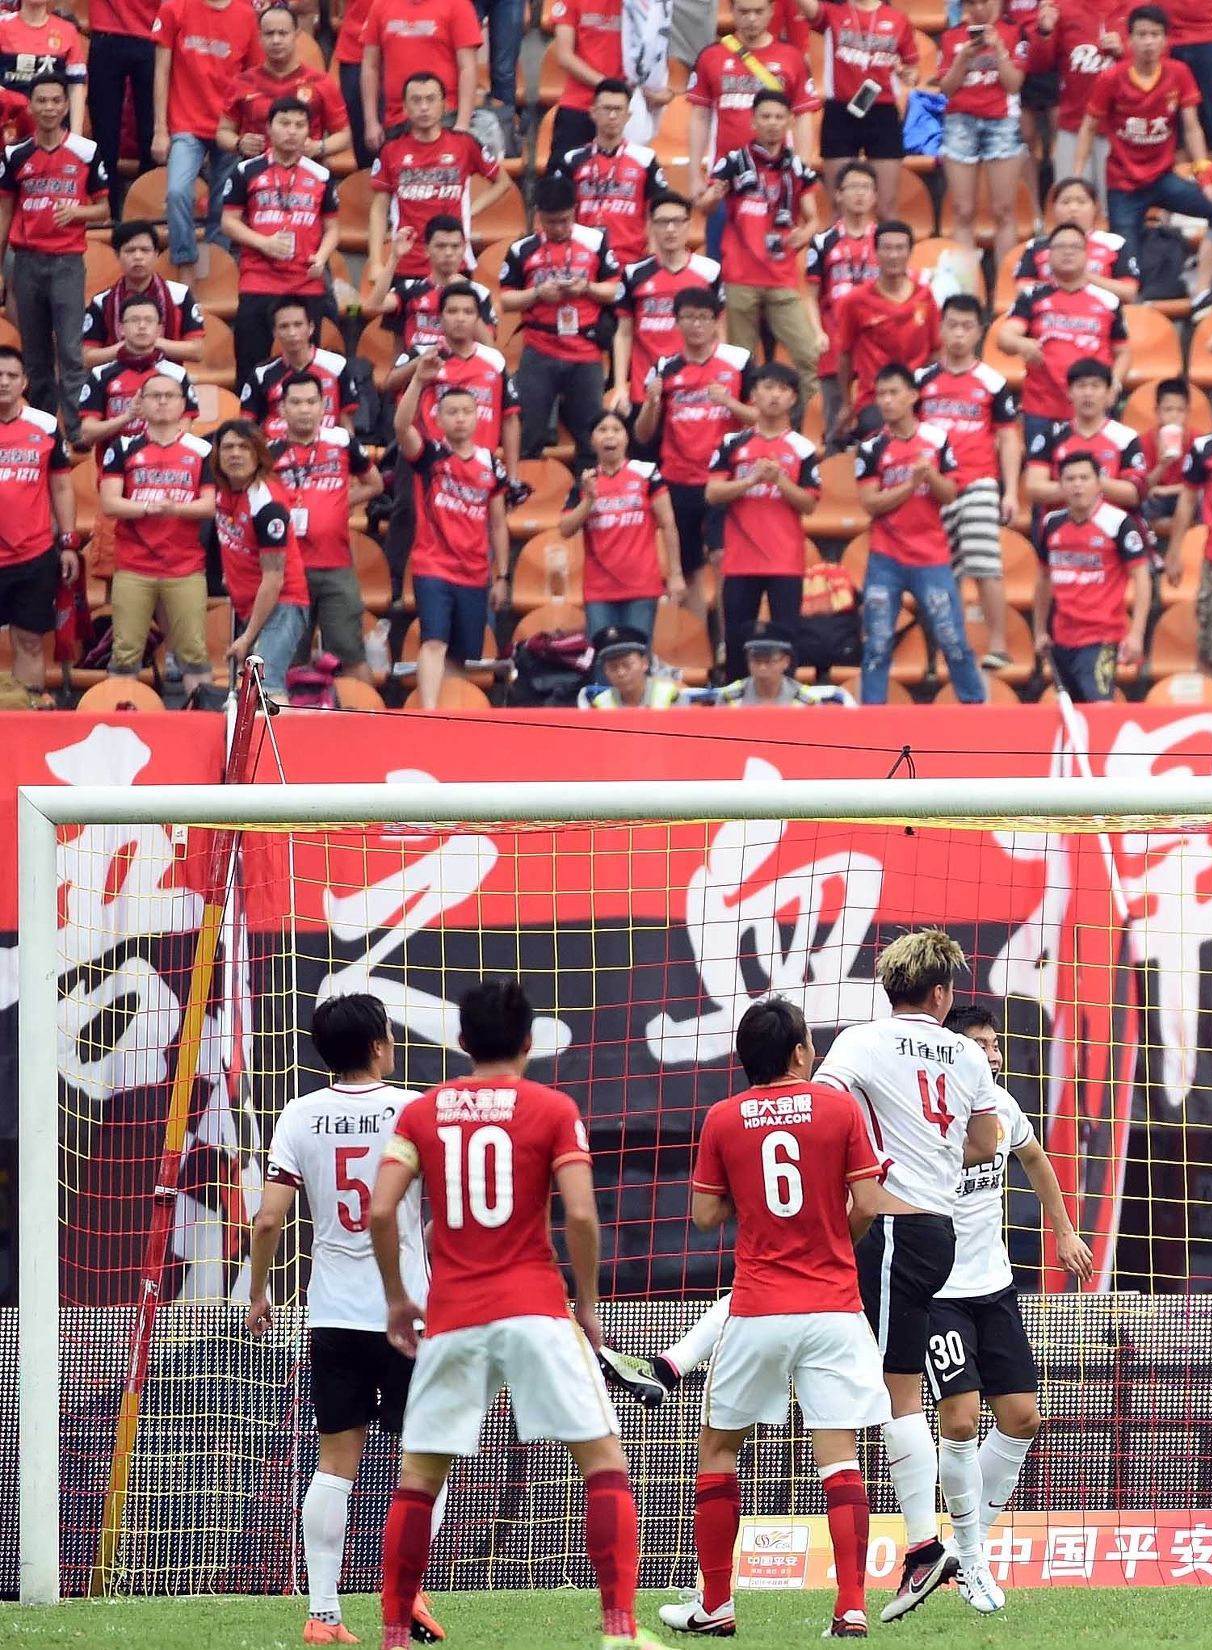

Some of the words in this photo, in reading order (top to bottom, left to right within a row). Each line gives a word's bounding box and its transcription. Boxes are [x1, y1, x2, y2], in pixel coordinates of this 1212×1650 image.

[895, 1036, 955, 1065] 孔雀城
[740, 1093, 813, 1118] 恒大金服
[916, 1068, 956, 1138] 4
[311, 1112, 381, 1135] 孔雀城
[744, 1113, 812, 1129] HDFAX.COM
[335, 1146, 371, 1233] 5
[437, 1125, 513, 1229] 10
[760, 1130, 804, 1218] 6
[929, 1330, 966, 1372] 30
[747, 1556, 798, 1567] 中国平安
